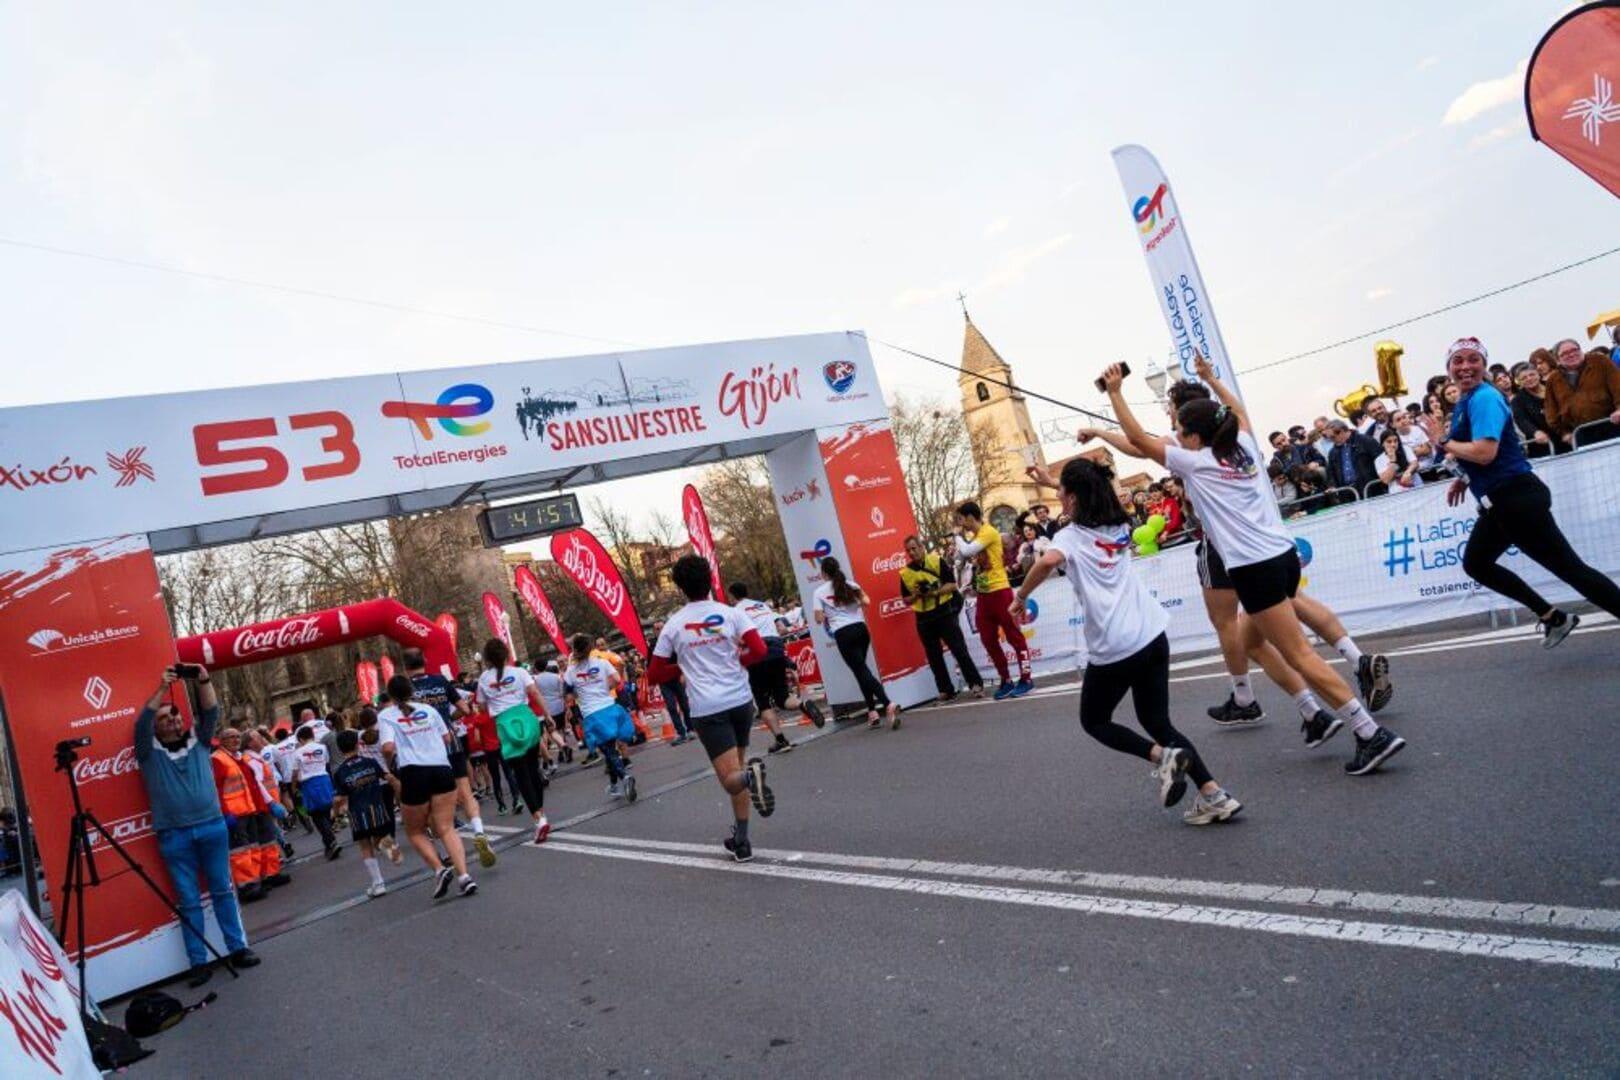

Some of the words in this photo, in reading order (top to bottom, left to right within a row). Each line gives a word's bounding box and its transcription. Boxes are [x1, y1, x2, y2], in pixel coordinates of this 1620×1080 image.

[718, 362, 802, 429] Gijón
[546, 405, 707, 452] SANSILVESTRE
[191, 409, 361, 497] 53
[392, 442, 507, 471] TotalEnergies
[1419, 579, 1482, 597] totalenerg
[62, 630, 105, 646] Unicaja
[104, 625, 139, 638] Banco
[232, 614, 324, 657] Coca-Cola
[73, 745, 140, 787] Coca-Co
